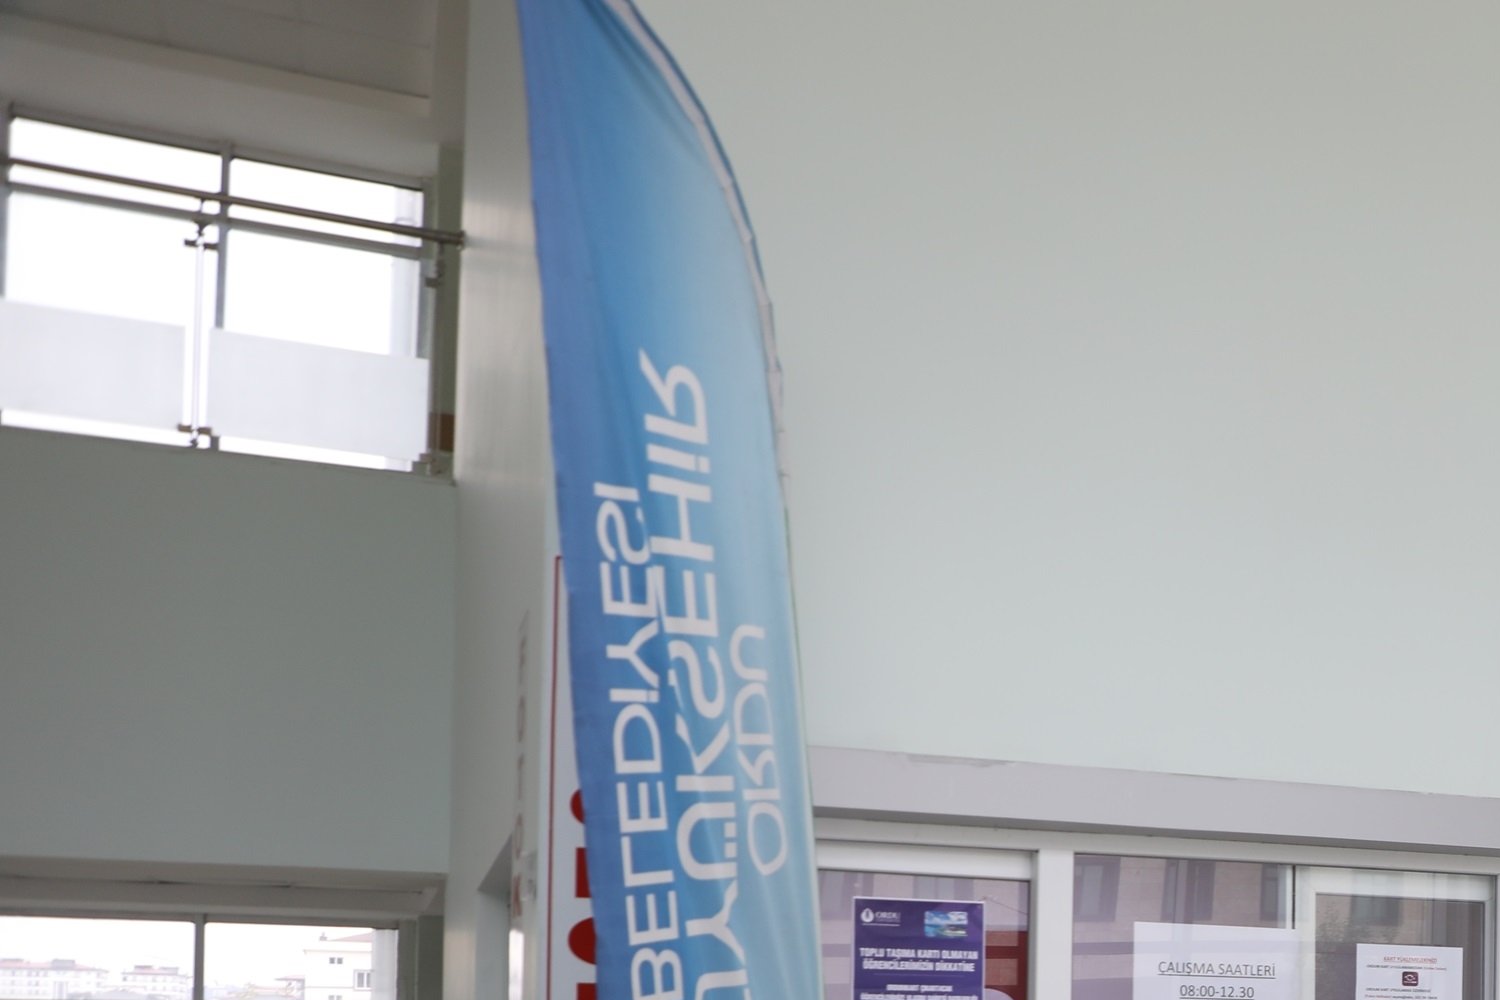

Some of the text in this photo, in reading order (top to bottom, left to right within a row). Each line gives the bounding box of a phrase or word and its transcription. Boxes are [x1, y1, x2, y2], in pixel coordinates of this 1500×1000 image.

[859, 948, 978, 960] TOPLU TAŞIMA KARTI OLMAYAN
[863, 958, 975, 972] ÖĞRENCİLERİMİZİN DİKKATİNE
[1158, 961, 1276, 977] ÇALIŞMA SAATLERİ
[1179, 984, 1255, 998] 08:00-12.30
